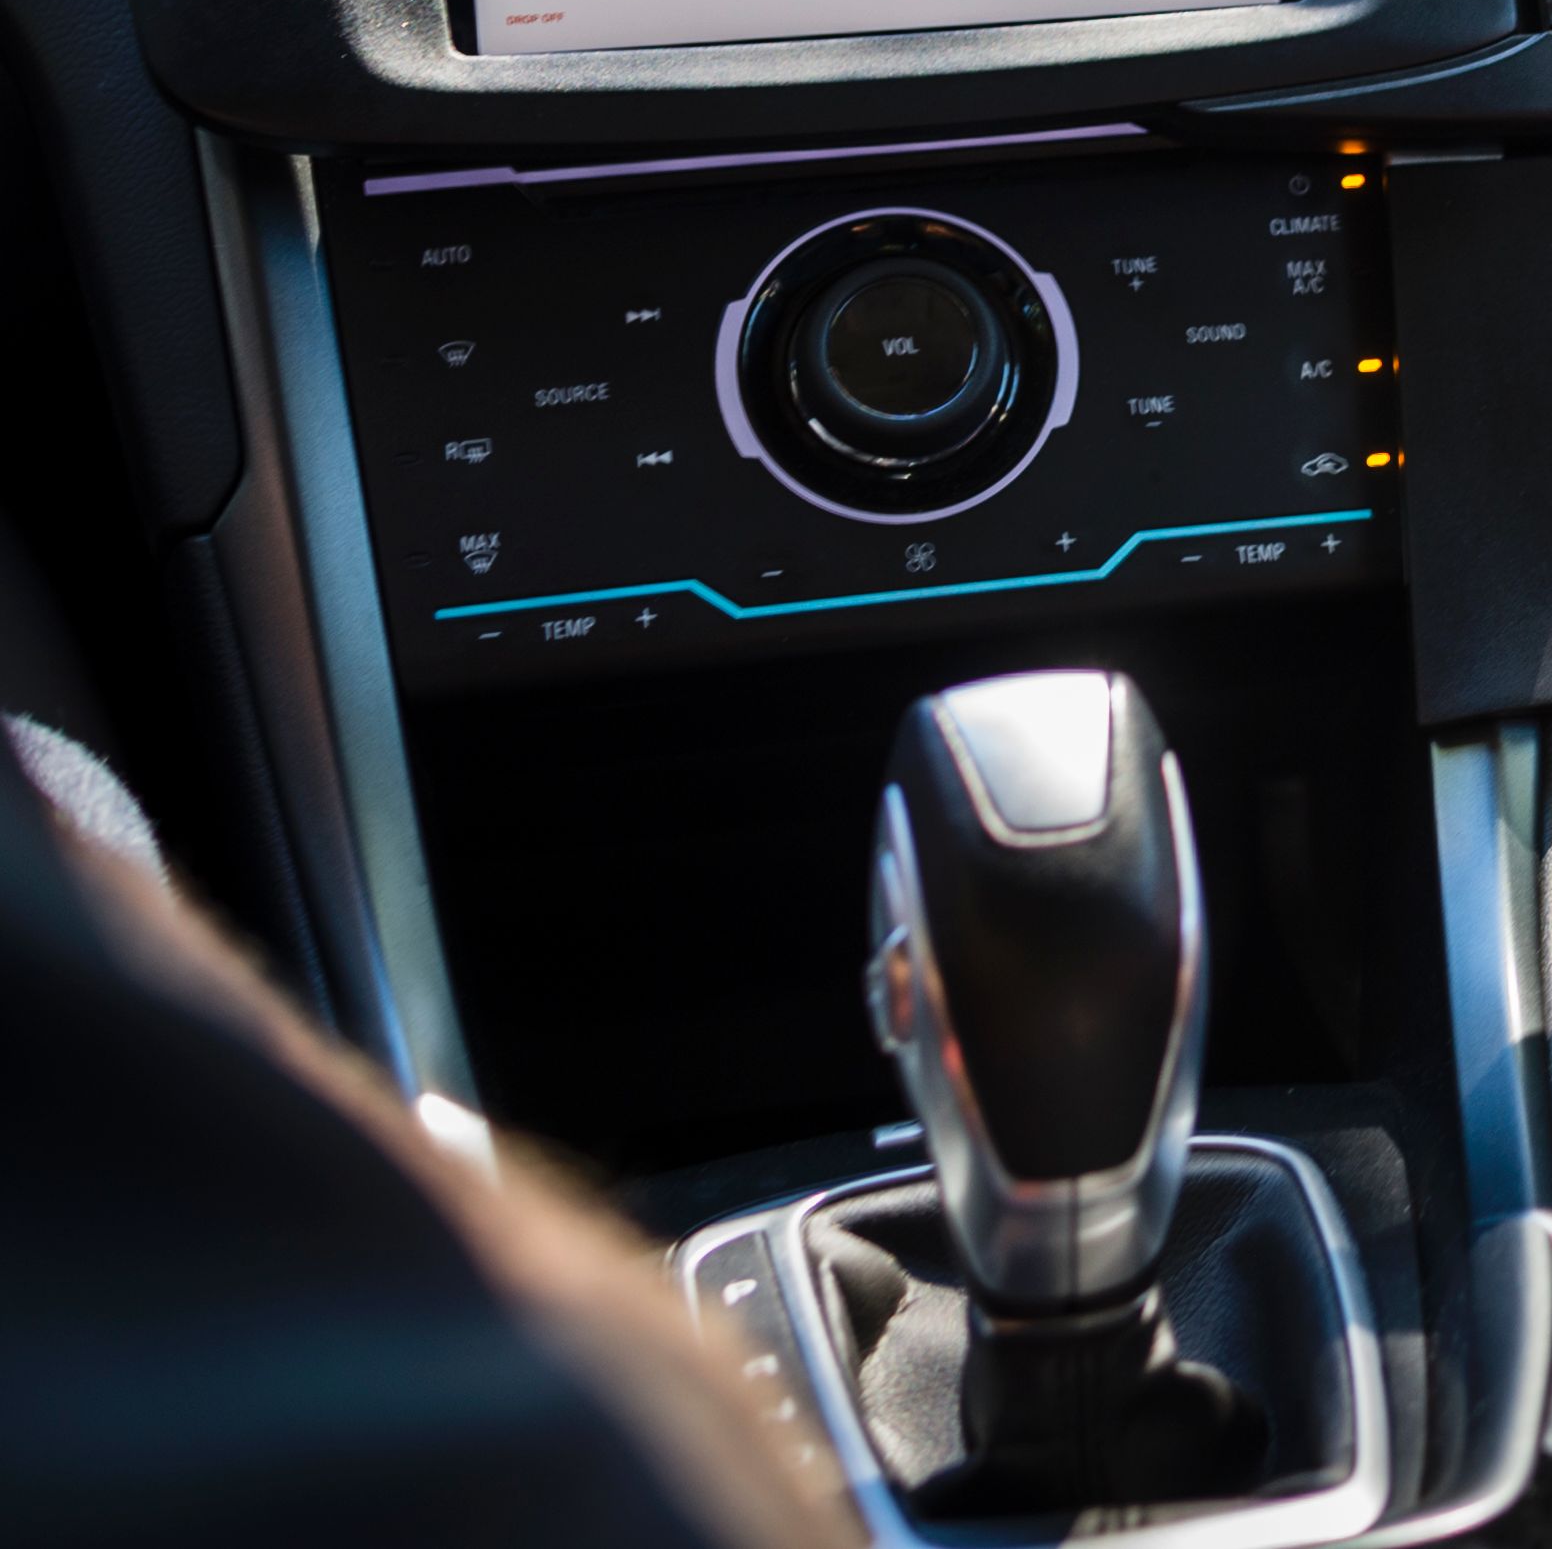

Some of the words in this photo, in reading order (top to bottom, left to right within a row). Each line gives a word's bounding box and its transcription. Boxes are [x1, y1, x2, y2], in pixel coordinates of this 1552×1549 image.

[506, 13, 539, 26] DROP
[541, 11, 565, 23] OFF
[1269, 214, 1342, 235] CLIMATE
[421, 245, 471, 267] AUTO
[1111, 256, 1158, 275] TUNE
[1286, 259, 1327, 279] MAX
[1293, 277, 1325, 296] A/C
[1186, 323, 1247, 344] SOUND
[882, 336, 920, 356] VOL
[1300, 359, 1333, 380] A/C
[534, 381, 610, 408] SOURCE
[1127, 395, 1175, 416] TUNE
[460, 532, 501, 553] MAX
[1235, 542, 1286, 564] TEMP
[541, 616, 596, 641] TEMP
